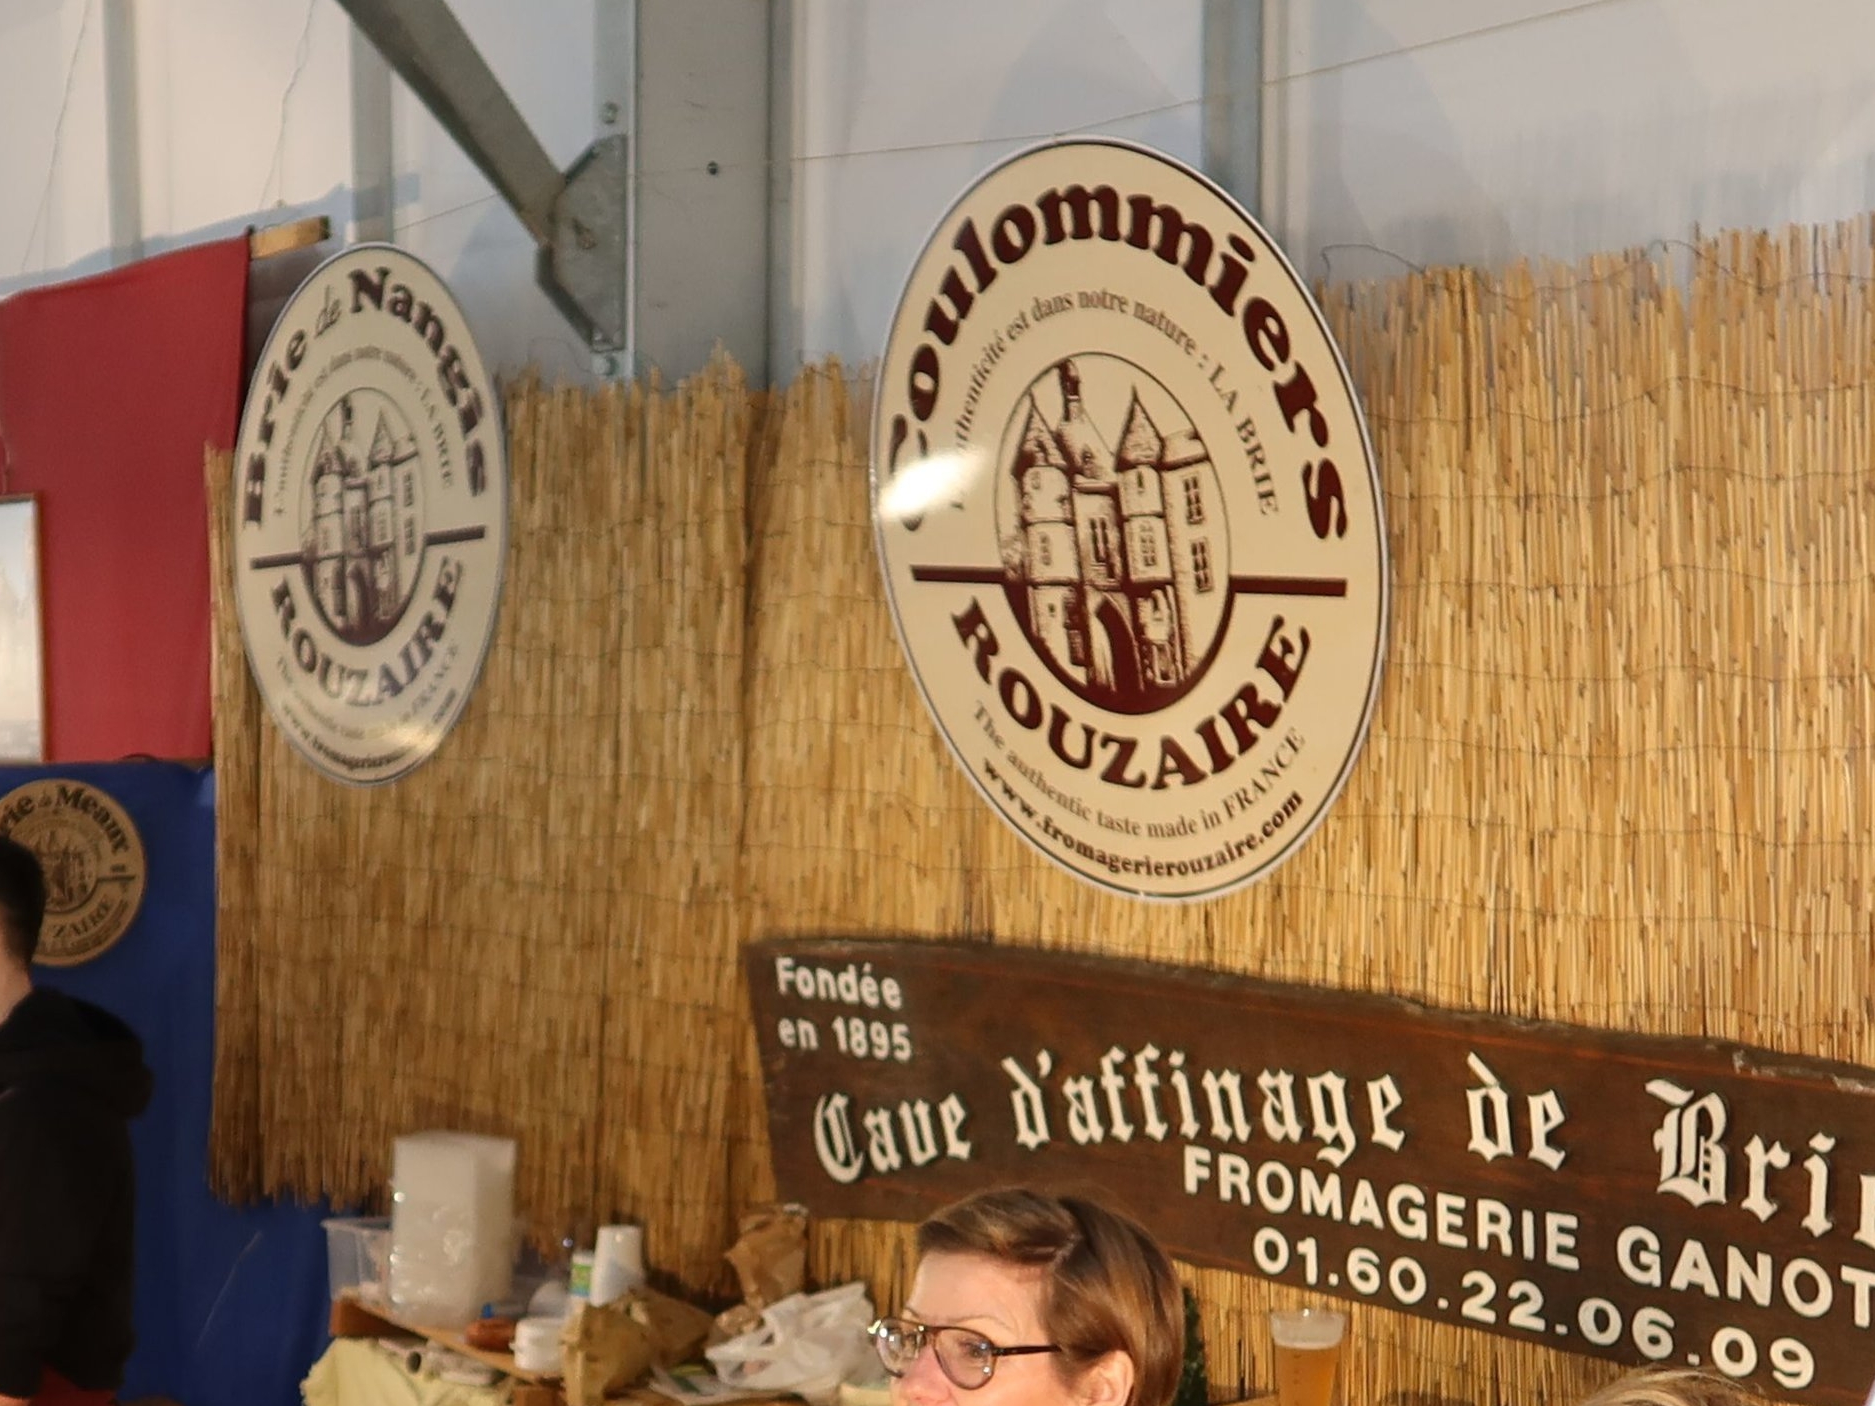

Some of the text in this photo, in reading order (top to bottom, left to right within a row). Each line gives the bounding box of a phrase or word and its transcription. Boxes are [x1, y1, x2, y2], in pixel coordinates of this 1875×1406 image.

[243, 328, 307, 530] Brie
[315, 284, 341, 338] de
[348, 266, 486, 497] Nangis
[1005, 312, 1032, 342] est
[1032, 289, 1073, 323] dans
[1077, 289, 1129, 313] notre
[1132, 301, 1197, 356] nature
[1208, 363, 1236, 416] LA
[1236, 416, 1279, 517] BRIE
[271, 555, 463, 707] ROUZAIRE
[950, 595, 1312, 791] ROUZAIRE
[55, 785, 130, 855] Meaux
[973, 699, 1309, 840] The authentic taste made in FRANCE
[982, 757, 1304, 878] www.fromagerierouzaire.com
[53, 895, 111, 939] ZAIRE
[774, 956, 903, 1009] Fondée
[778, 1015, 911, 1062] en 1895
[813, 1092, 972, 1184] Cave
[1002, 1042, 1406, 1168] d'affinage
[1465, 1051, 1568, 1172] de
[1182, 1145, 1580, 1271] FROMAGERIE
[1252, 1227, 1815, 1389] 01.60.22.06.09
